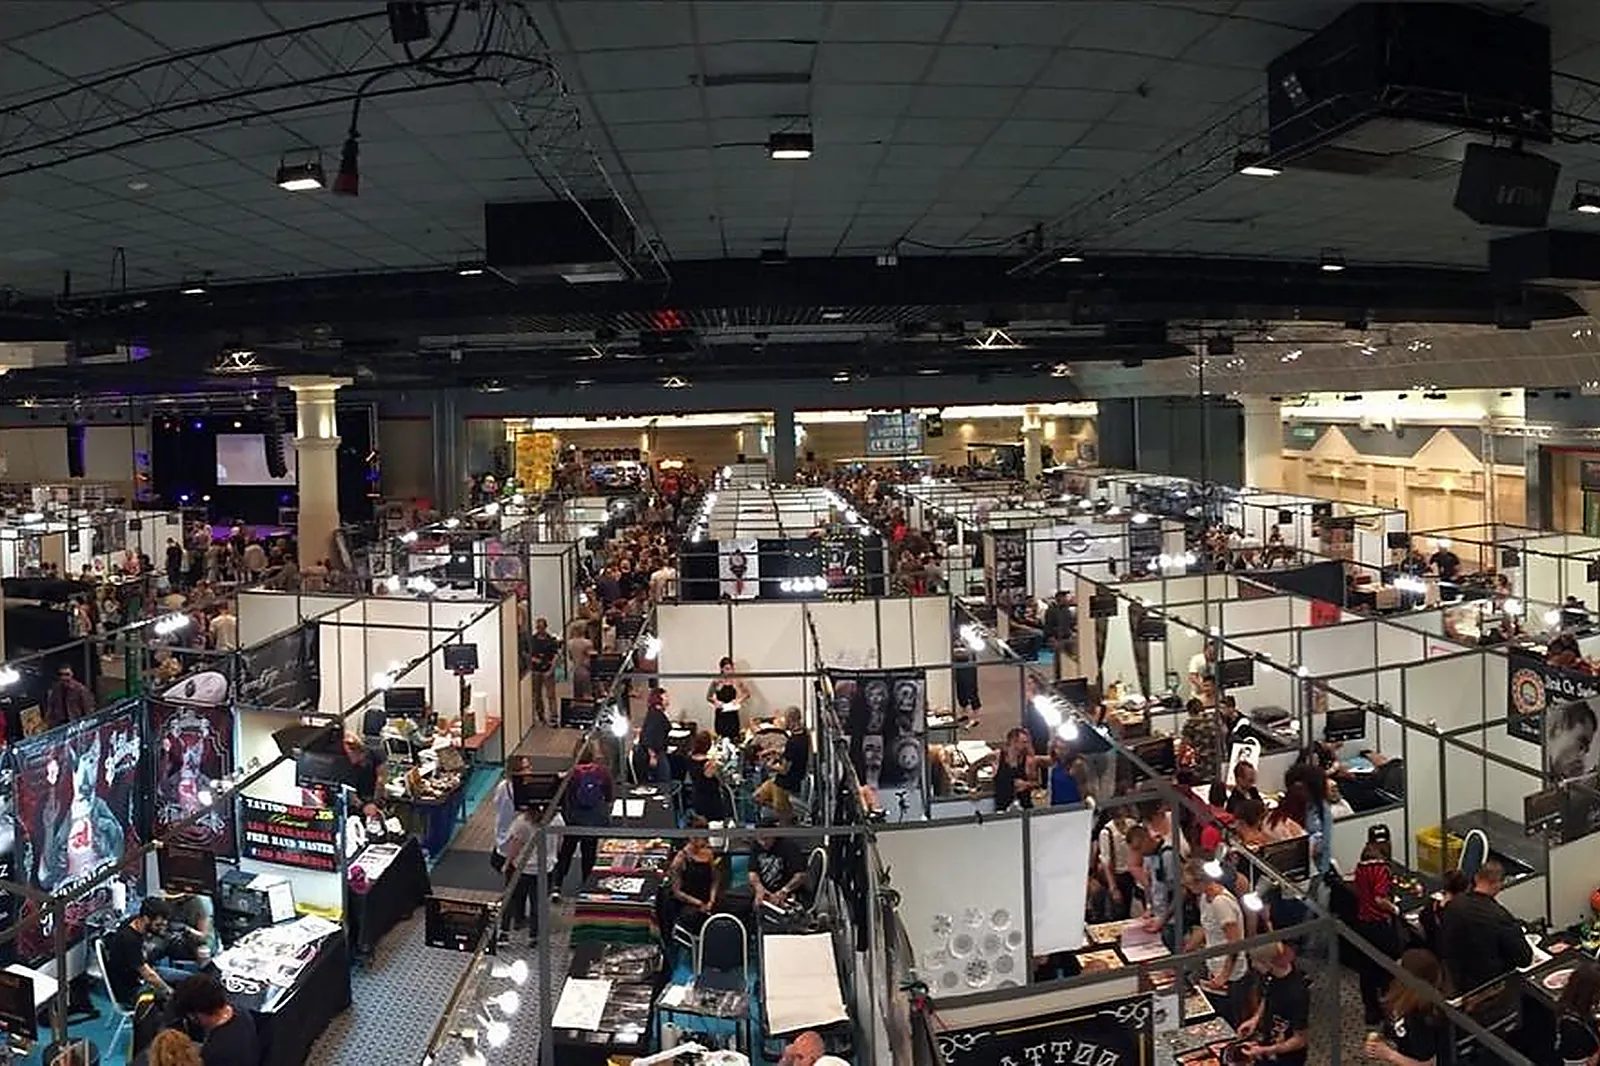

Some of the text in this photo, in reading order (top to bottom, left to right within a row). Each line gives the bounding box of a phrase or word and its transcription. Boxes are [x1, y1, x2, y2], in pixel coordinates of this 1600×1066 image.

[246, 832, 270, 845] FREE
[271, 836, 297, 849] HAND
[298, 840, 335, 855] MASTER
